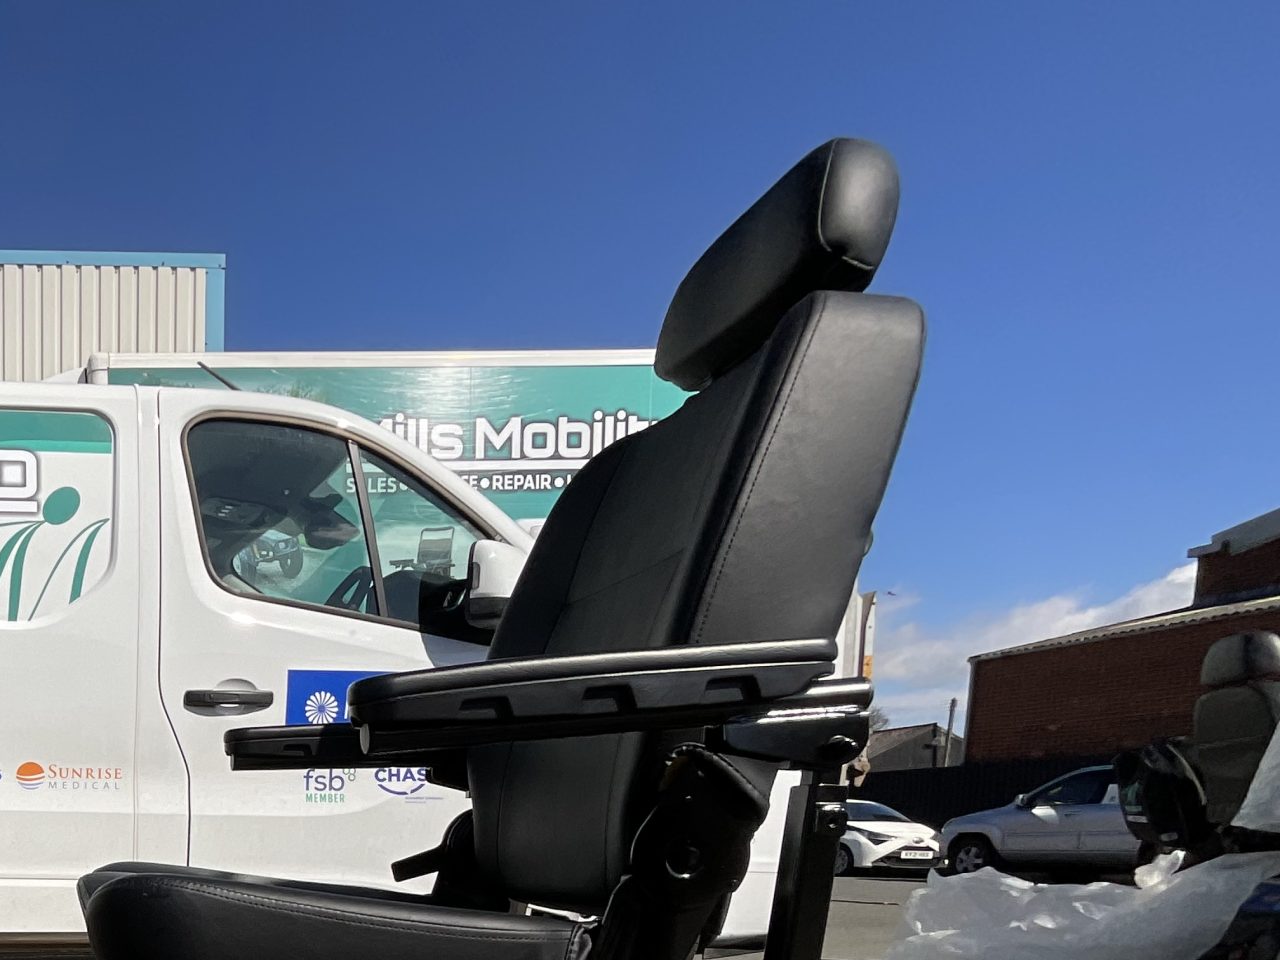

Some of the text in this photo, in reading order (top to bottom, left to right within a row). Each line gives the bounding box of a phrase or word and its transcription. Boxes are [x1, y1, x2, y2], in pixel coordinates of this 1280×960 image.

[380, 413, 464, 460] ills
[346, 477, 397, 493] SLES
[492, 474, 552, 490] REPAIR
[48, 781, 120, 790] MEDICAL
[303, 768, 345, 791] fsb
[305, 793, 345, 803] MEMBER
